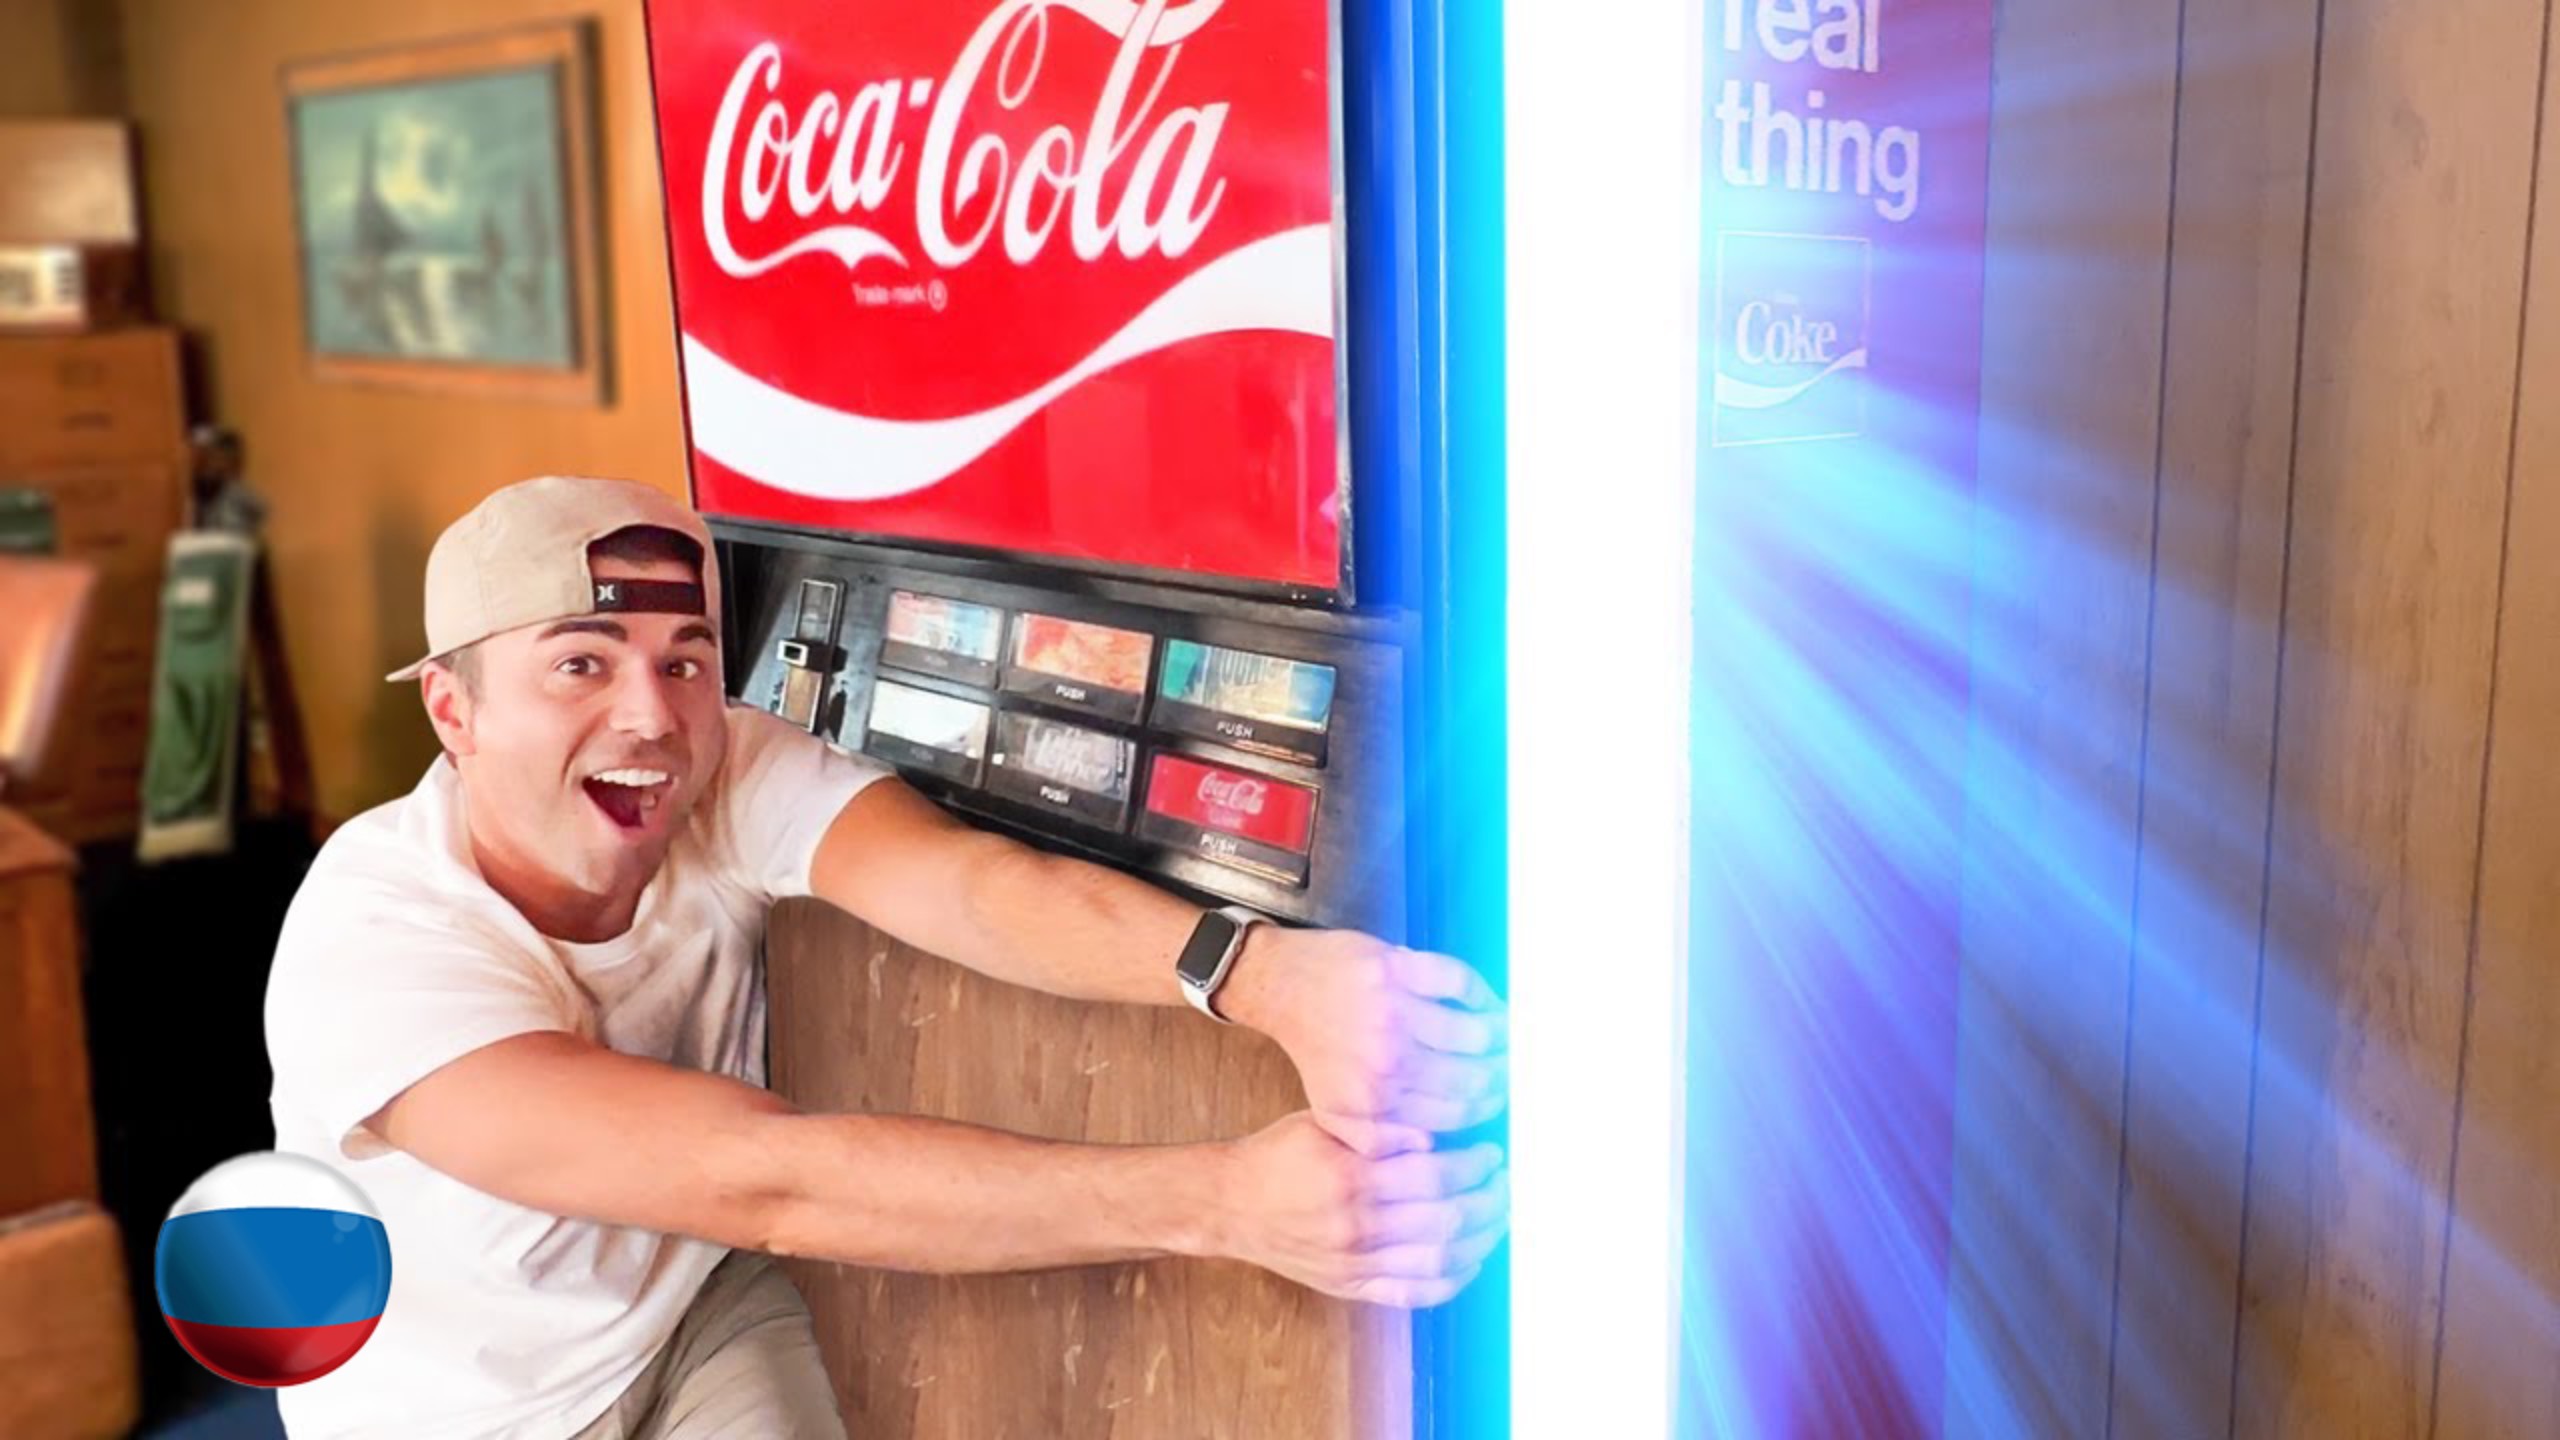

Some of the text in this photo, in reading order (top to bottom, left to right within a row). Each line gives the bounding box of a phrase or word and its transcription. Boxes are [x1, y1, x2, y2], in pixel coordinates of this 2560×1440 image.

[702, 0, 1231, 278] Coca-Cola
[1714, 78, 1920, 222] thing
[1736, 300, 1837, 364] Coke
[1216, 719, 1254, 739] PUSH
[1200, 833, 1238, 855] PUSH
